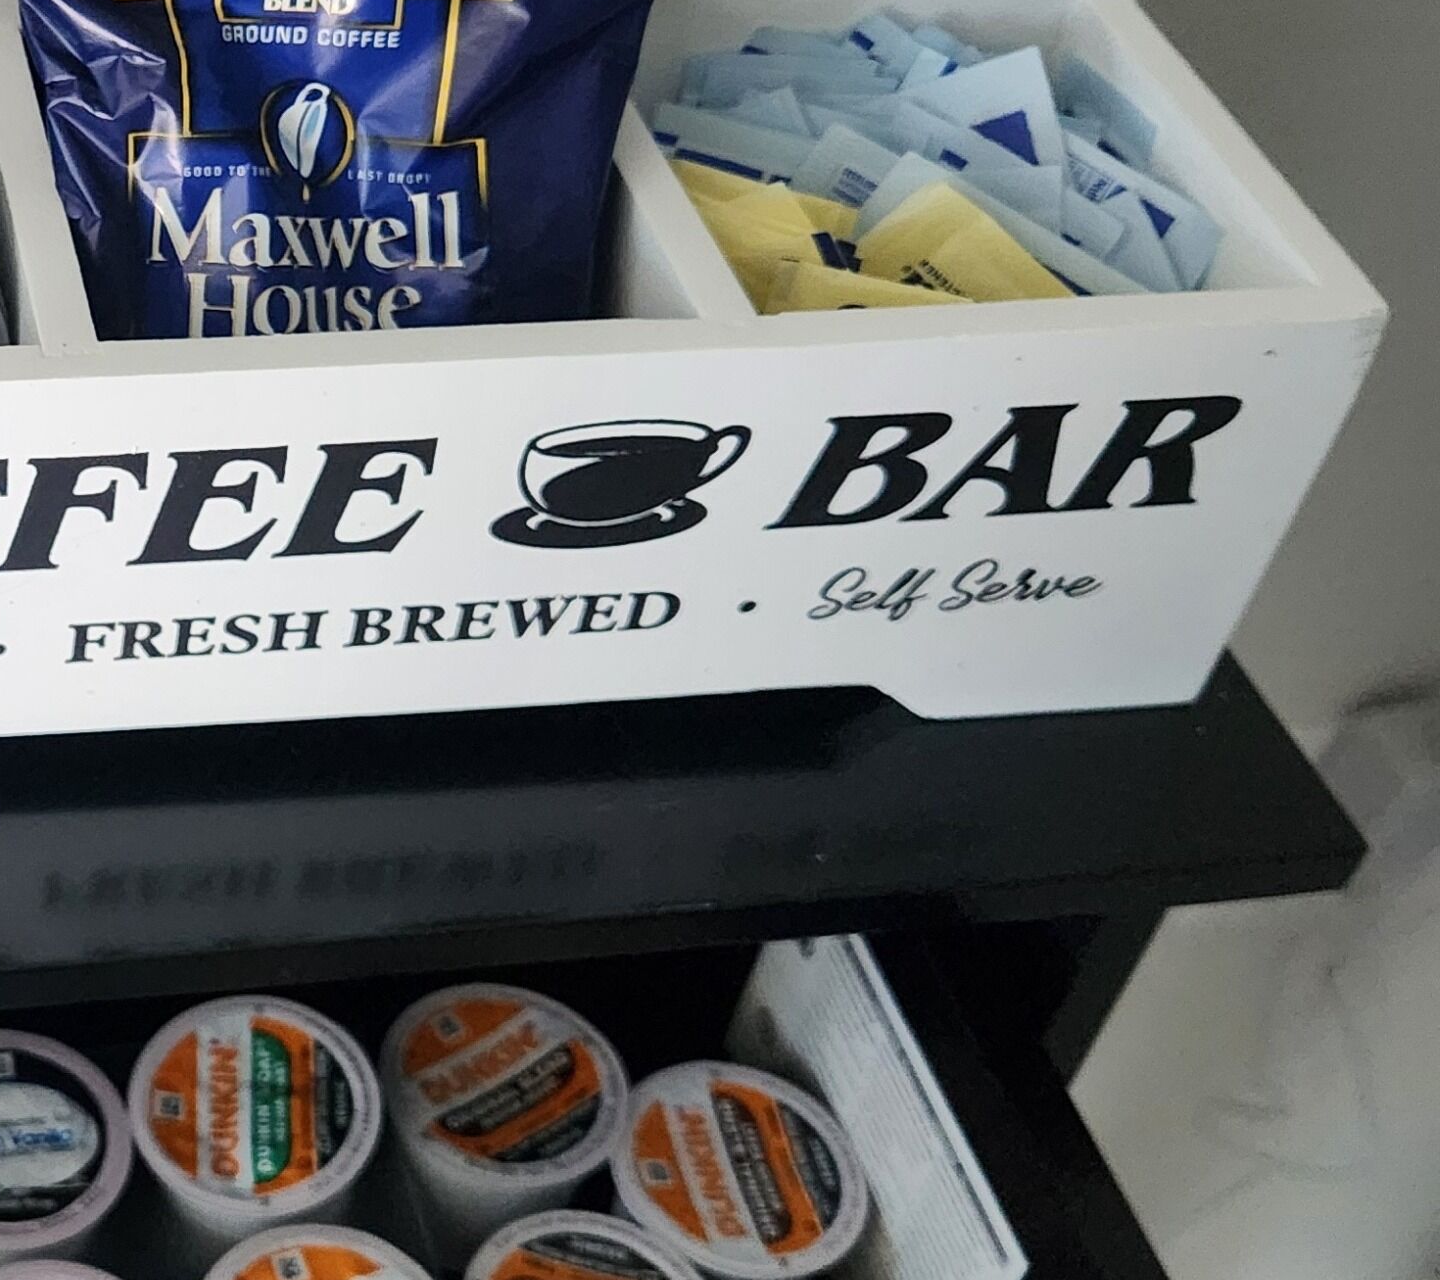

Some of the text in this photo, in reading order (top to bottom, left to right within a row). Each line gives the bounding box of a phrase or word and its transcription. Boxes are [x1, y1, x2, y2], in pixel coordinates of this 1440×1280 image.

[221, 25, 402, 48] GROUND COFFEE
[183, 166, 225, 178] GOOD
[228, 165, 246, 177] TO
[347, 170, 383, 182] LAST
[147, 187, 466, 271] Maxwell
[186, 273, 422, 338] House
[761, 394, 1244, 531] BAR
[807, 558, 1106, 623] Self Serve
[64, 590, 682, 664] FRESH BREWED
